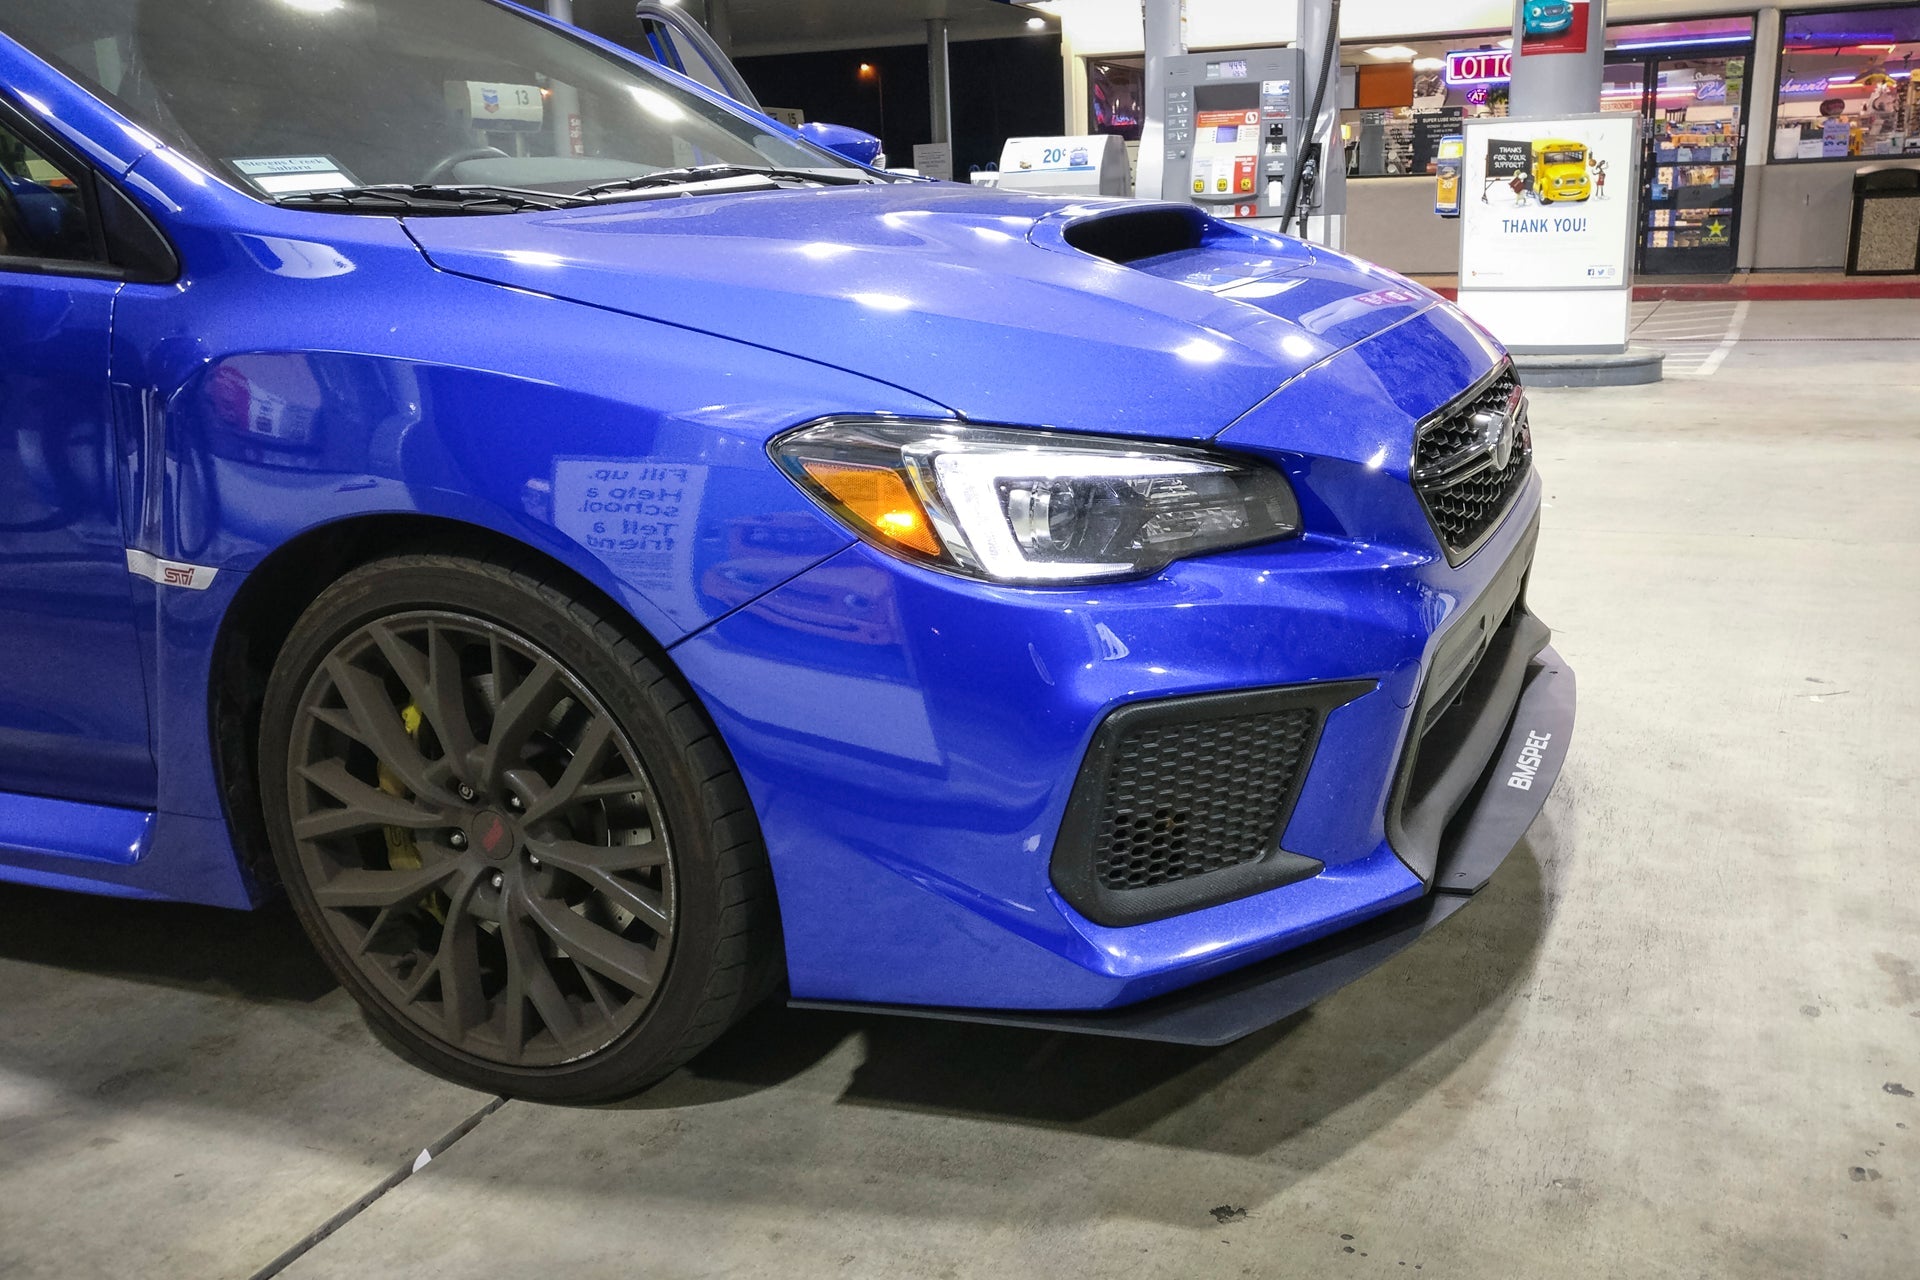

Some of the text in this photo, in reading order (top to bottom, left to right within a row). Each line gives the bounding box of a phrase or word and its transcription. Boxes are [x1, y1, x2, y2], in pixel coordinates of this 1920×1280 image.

[515, 90, 529, 105] 13
[787, 113, 797, 124] 15
[1502, 218, 1586, 233] THANK YOU!
[1507, 730, 1552, 791] BMSPEC
